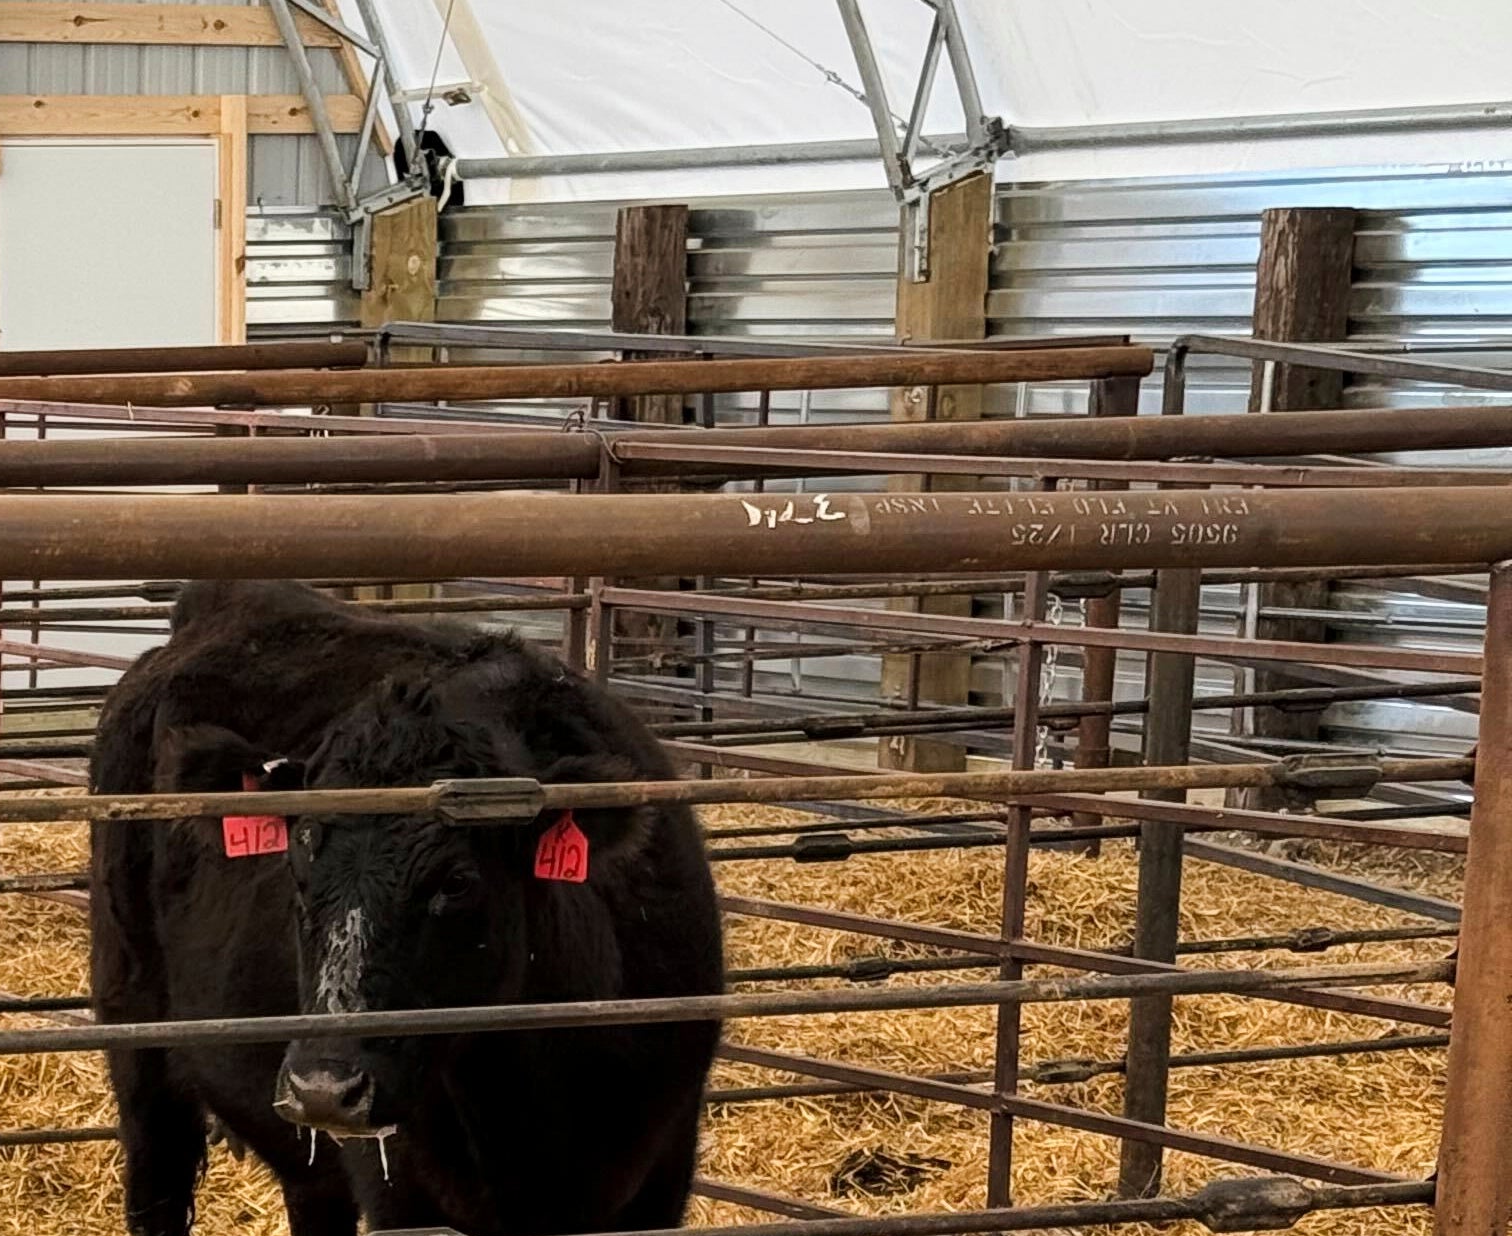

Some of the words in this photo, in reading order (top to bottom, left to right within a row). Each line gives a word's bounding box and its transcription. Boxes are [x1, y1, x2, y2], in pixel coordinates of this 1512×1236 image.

[1010, 523, 1076, 546] 1/25
[1099, 523, 1151, 546] CLR
[1170, 523, 1239, 546] 9505
[230, 821, 280, 855] 412
[539, 842, 582, 878] 412
